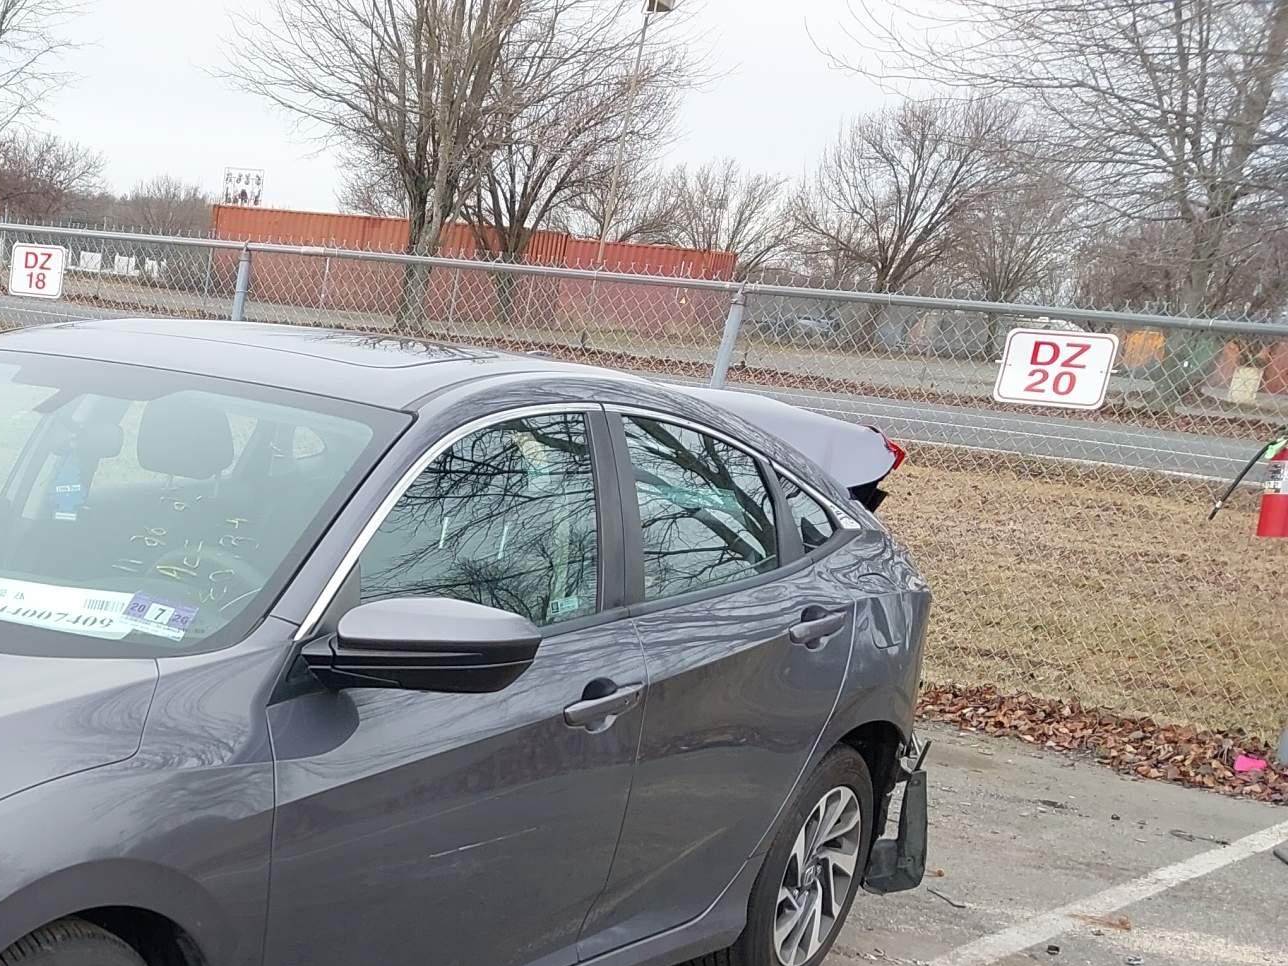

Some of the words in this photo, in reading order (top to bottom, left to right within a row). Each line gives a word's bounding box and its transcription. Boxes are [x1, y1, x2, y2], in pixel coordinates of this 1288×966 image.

[24, 251, 53, 271] DZ
[26, 272, 46, 290] 18
[1030, 340, 1092, 369] DZ
[1023, 367, 1078, 396] 20
[154, 607, 167, 620] 7
